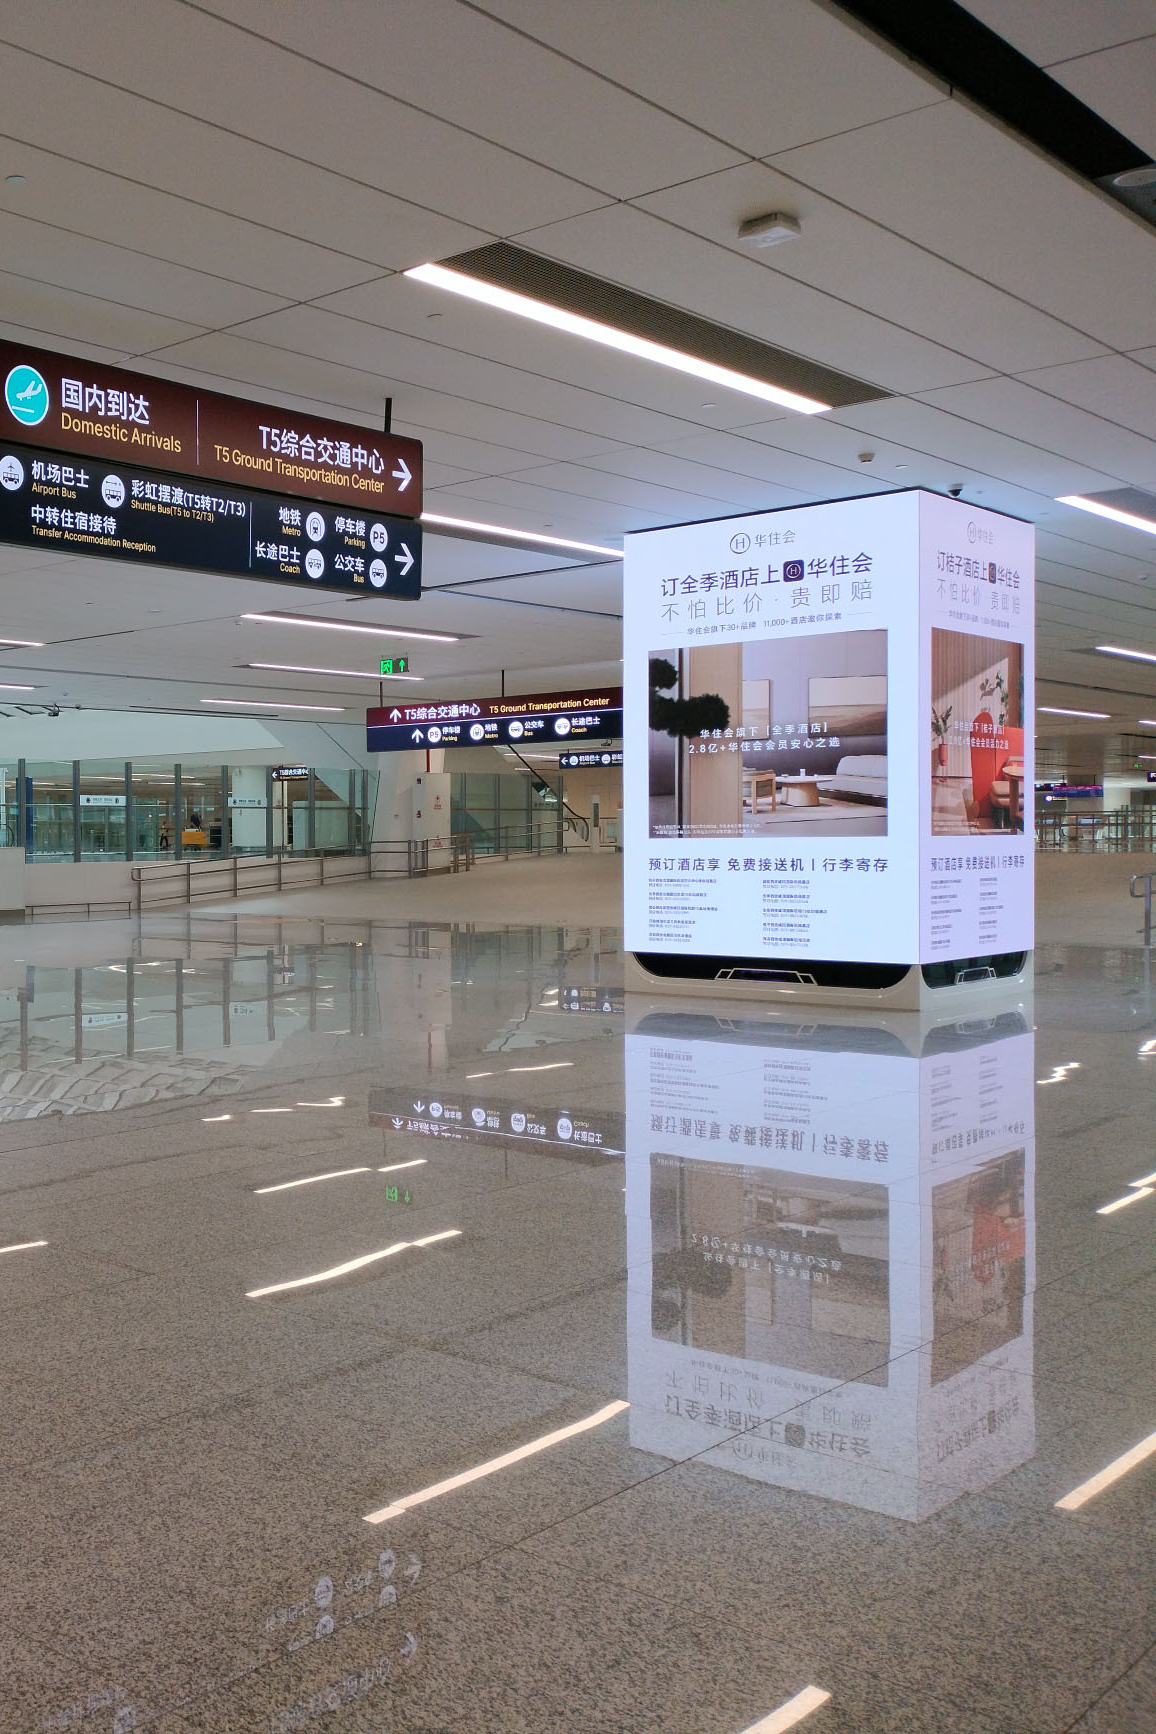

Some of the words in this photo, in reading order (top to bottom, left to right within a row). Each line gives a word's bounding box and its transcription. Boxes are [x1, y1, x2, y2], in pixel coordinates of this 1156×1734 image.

[62, 377, 150, 425] 国内到达
[62, 412, 128, 442] Domestic
[131, 428, 182, 453] Arrivals
[258, 425, 385, 475] T5综合交通中心
[31, 460, 90, 488] 机场巴士
[214, 444, 230, 463] T5
[232, 449, 273, 473] Ground
[275, 458, 350, 488] Transportation
[352, 473, 385, 494] Center
[32, 482, 60, 497] Airport
[61, 487, 77, 499] Bus
[131, 479, 246, 517] 彩虹摆渡(T5转T2/T3)
[31, 504, 117, 535] 中转住宿接待
[131, 500, 156, 512] Shuttle
[183, 510, 191, 518] to
[192, 510, 214, 524] T2/T3)
[278, 506, 302, 527] 地铁
[282, 525, 301, 537] Metro
[334, 516, 366, 537] 停车楼
[32, 525, 63, 539] Transfer
[64, 530, 121, 548] Accommodation
[122, 538, 157, 553] Reception
[344, 536, 366, 550] Parking
[372, 531, 385, 545] P5
[754, 530, 796, 548] 华住会
[254, 540, 301, 564] 长途巴士
[280, 564, 301, 574] Coach
[334, 553, 365, 573] 公交车
[353, 573, 365, 583] Bus
[661, 564, 781, 597] 订全季酒店上
[807, 552, 873, 579] 华住会
[404, 703, 481, 720] T5综合交通中心
[489, 705, 499, 714] T5
[500, 704, 526, 713] Ground
[528, 699, 582, 711] Transportation
[583, 697, 610, 707] Center
[571, 716, 601, 726] 长途巴士
[700, 726, 759, 739] 华住会旗下
[688, 737, 841, 754] 2.8亿+华住会会员安心之选
[648, 858, 721, 872] 预订酒店享
[727, 858, 805, 873] 免费接送机
[822, 858, 889, 873] 行李寄存
